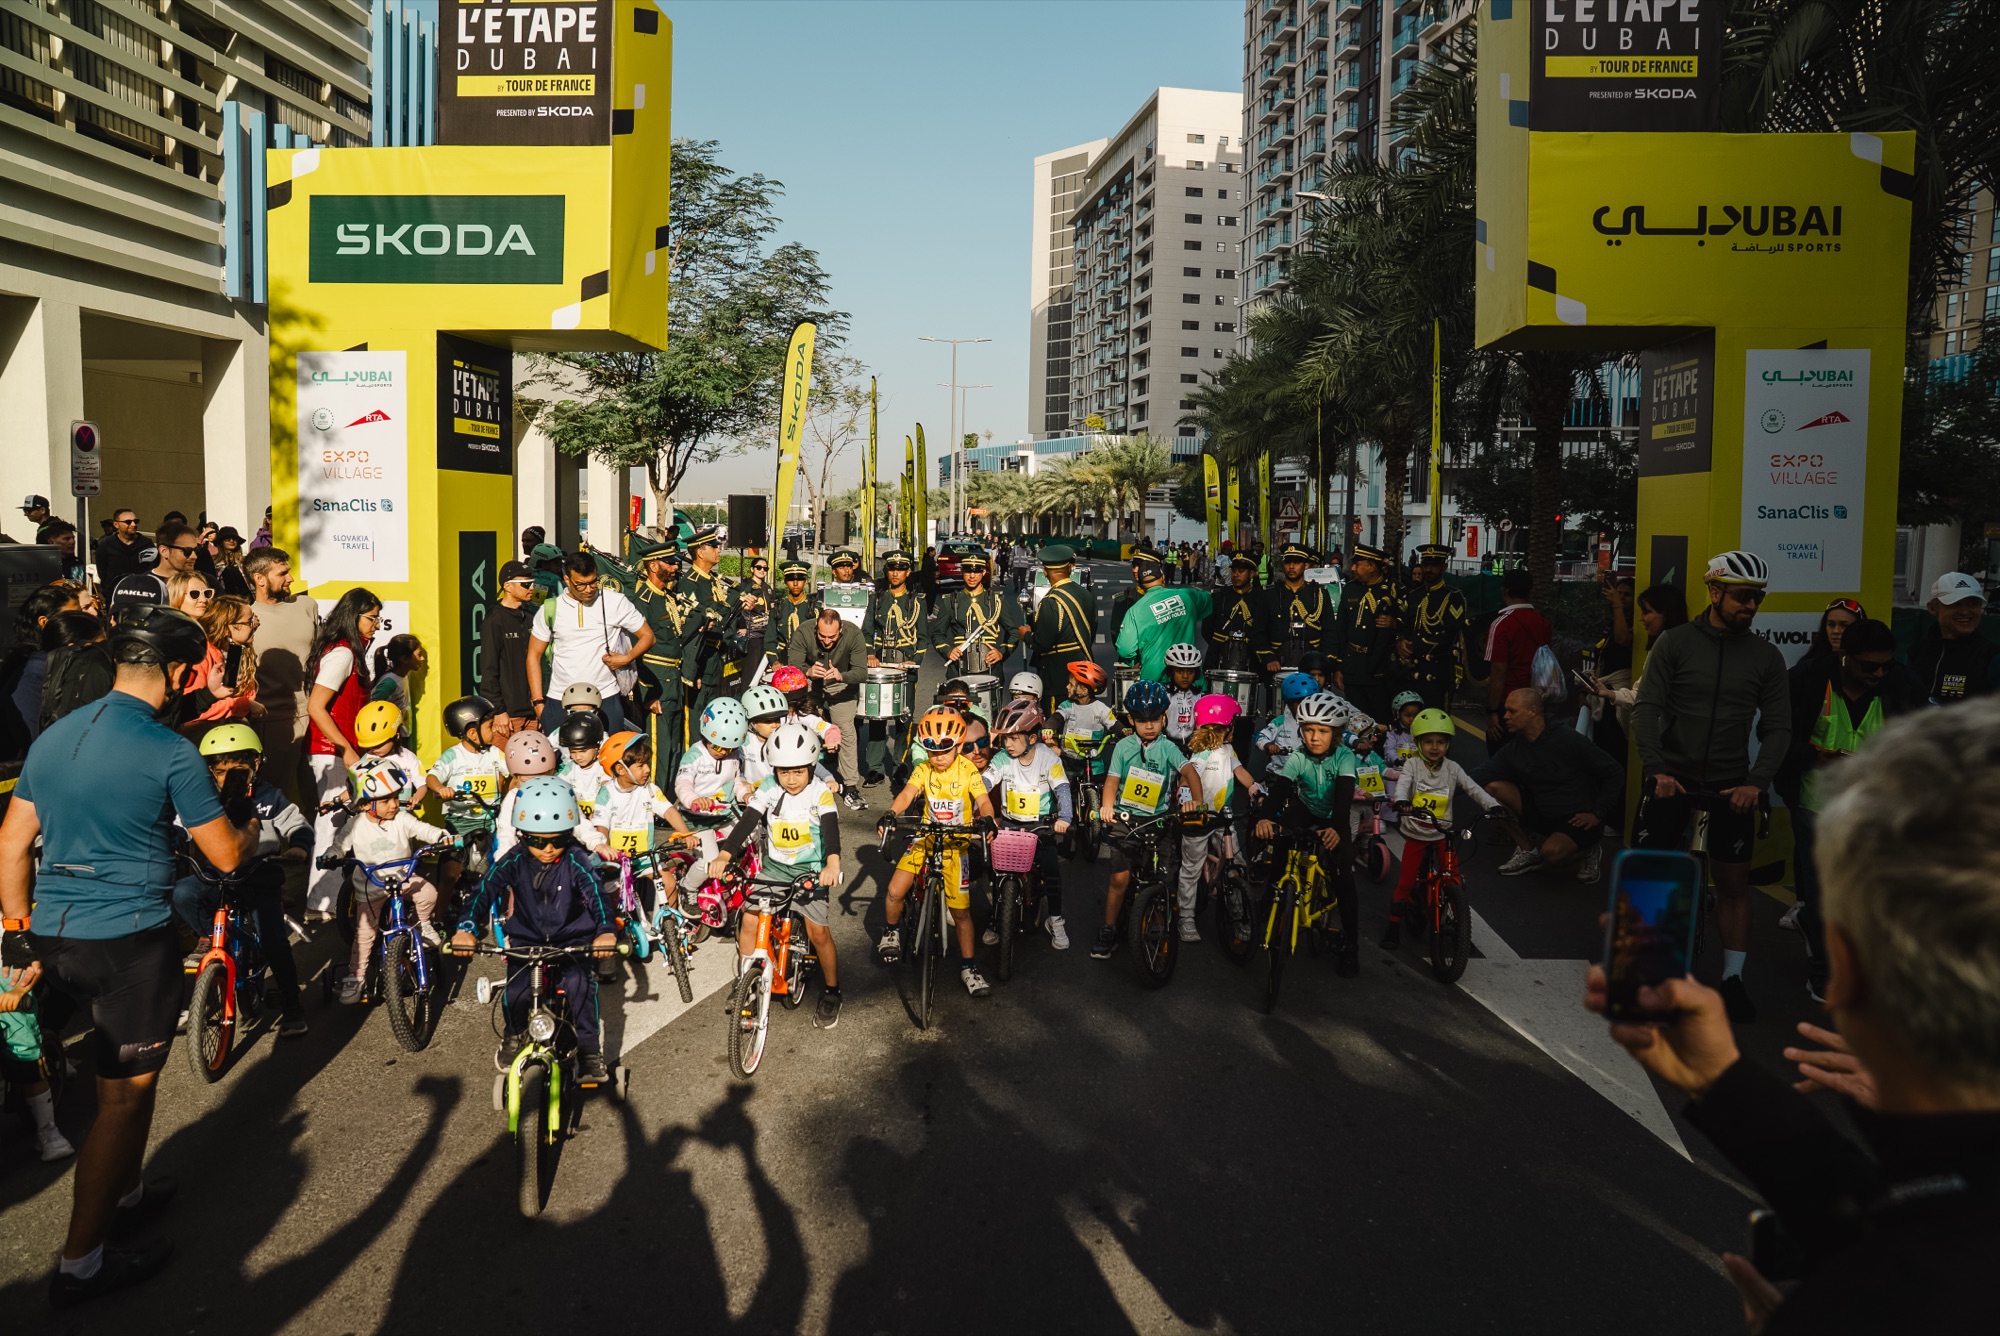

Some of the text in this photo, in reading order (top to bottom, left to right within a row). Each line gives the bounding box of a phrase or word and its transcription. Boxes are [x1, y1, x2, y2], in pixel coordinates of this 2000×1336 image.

[1546, 0, 1699, 22] LETAPE
[1545, 28, 1699, 50] DUBAI
[457, 47, 597, 70] DUBAI
[1599, 60, 1629, 73] TOUR
[1632, 60, 1646, 73] DE
[1649, 60, 1693, 73] FRANCE
[506, 80, 532, 92] TOUR
[535, 80, 548, 91] DE
[550, 79, 591, 91] FRANCE
[1589, 91, 1623, 99] PRESENTED
[496, 109, 527, 117] PRESENTED
[1787, 243, 1842, 252] SPORTS
[453, 398, 500, 421] DUBAI
[1652, 398, 1698, 421] DUBAI
[366, 414, 384, 422] RTA
[1821, 416, 1842, 424] RTA
[323, 451, 369, 463] EXPO
[1771, 455, 1823, 467] EXPO
[323, 467, 382, 479] VILLAGE
[1771, 472, 1837, 484] VILLAGE
[313, 498, 377, 512] SanaClis
[1757, 505, 1829, 519] SanaClis
[342, 542, 369, 550] TRAVEL
[117, 590, 156, 598] OAKLEY
[472, 560, 486, 697] ODA
[474, 780, 487, 792] 39
[1366, 777, 1377, 787] 73
[1134, 784, 1150, 799] 82
[933, 802, 954, 811] UAE
[1019, 798, 1026, 809] 5
[1422, 798, 1437, 810] 24
[782, 828, 799, 841] 40
[622, 836, 637, 847] 75
